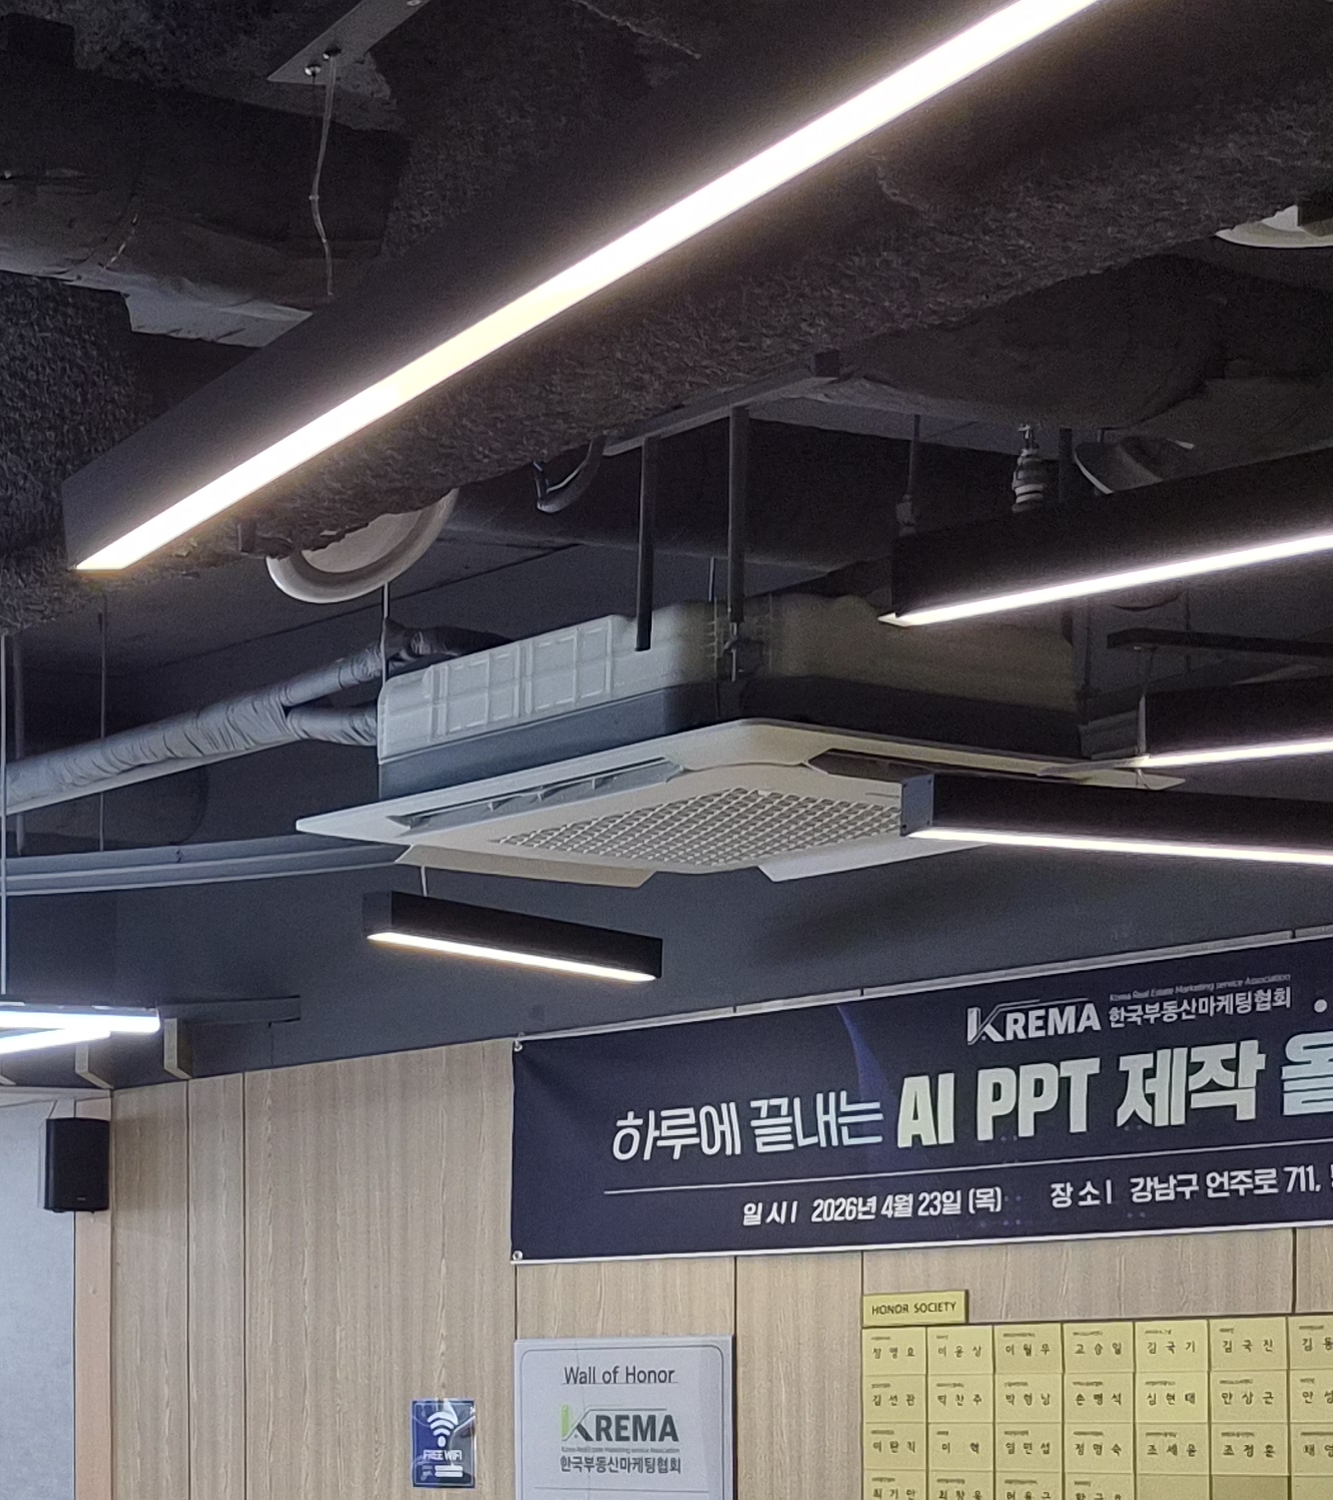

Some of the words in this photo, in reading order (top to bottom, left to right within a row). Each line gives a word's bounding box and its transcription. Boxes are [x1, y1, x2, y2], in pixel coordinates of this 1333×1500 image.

[1244, 973, 1292, 986] Association
[967, 998, 1102, 1045] KREMA
[1108, 986, 1291, 1029] 한국부동산마케팅협회
[612, 1102, 741, 1161] 하루에
[749, 1090, 884, 1154] 끝내는
[897, 1072, 955, 1149] AI
[976, 1056, 1101, 1141] PPT
[1116, 1039, 1266, 1127] 제작
[810, 1195, 877, 1223] 2026년
[881, 1193, 914, 1219] 4월
[917, 1190, 962, 1217] 23일
[968, 1187, 1002, 1215] (목)
[1130, 1171, 1199, 1202] 강남구
[1205, 1167, 1280, 1199] 언주로
[1282, 1164, 1322, 1193] 711,
[871, 1303, 910, 1316] HONOR
[914, 1301, 957, 1314] SOCIETY
[564, 1365, 596, 1385] Wall
[601, 1365, 620, 1385] of
[625, 1365, 676, 1384] Honor
[560, 1404, 680, 1442] KREMA
[560, 1455, 682, 1475] 한국부동산마케팅협회
